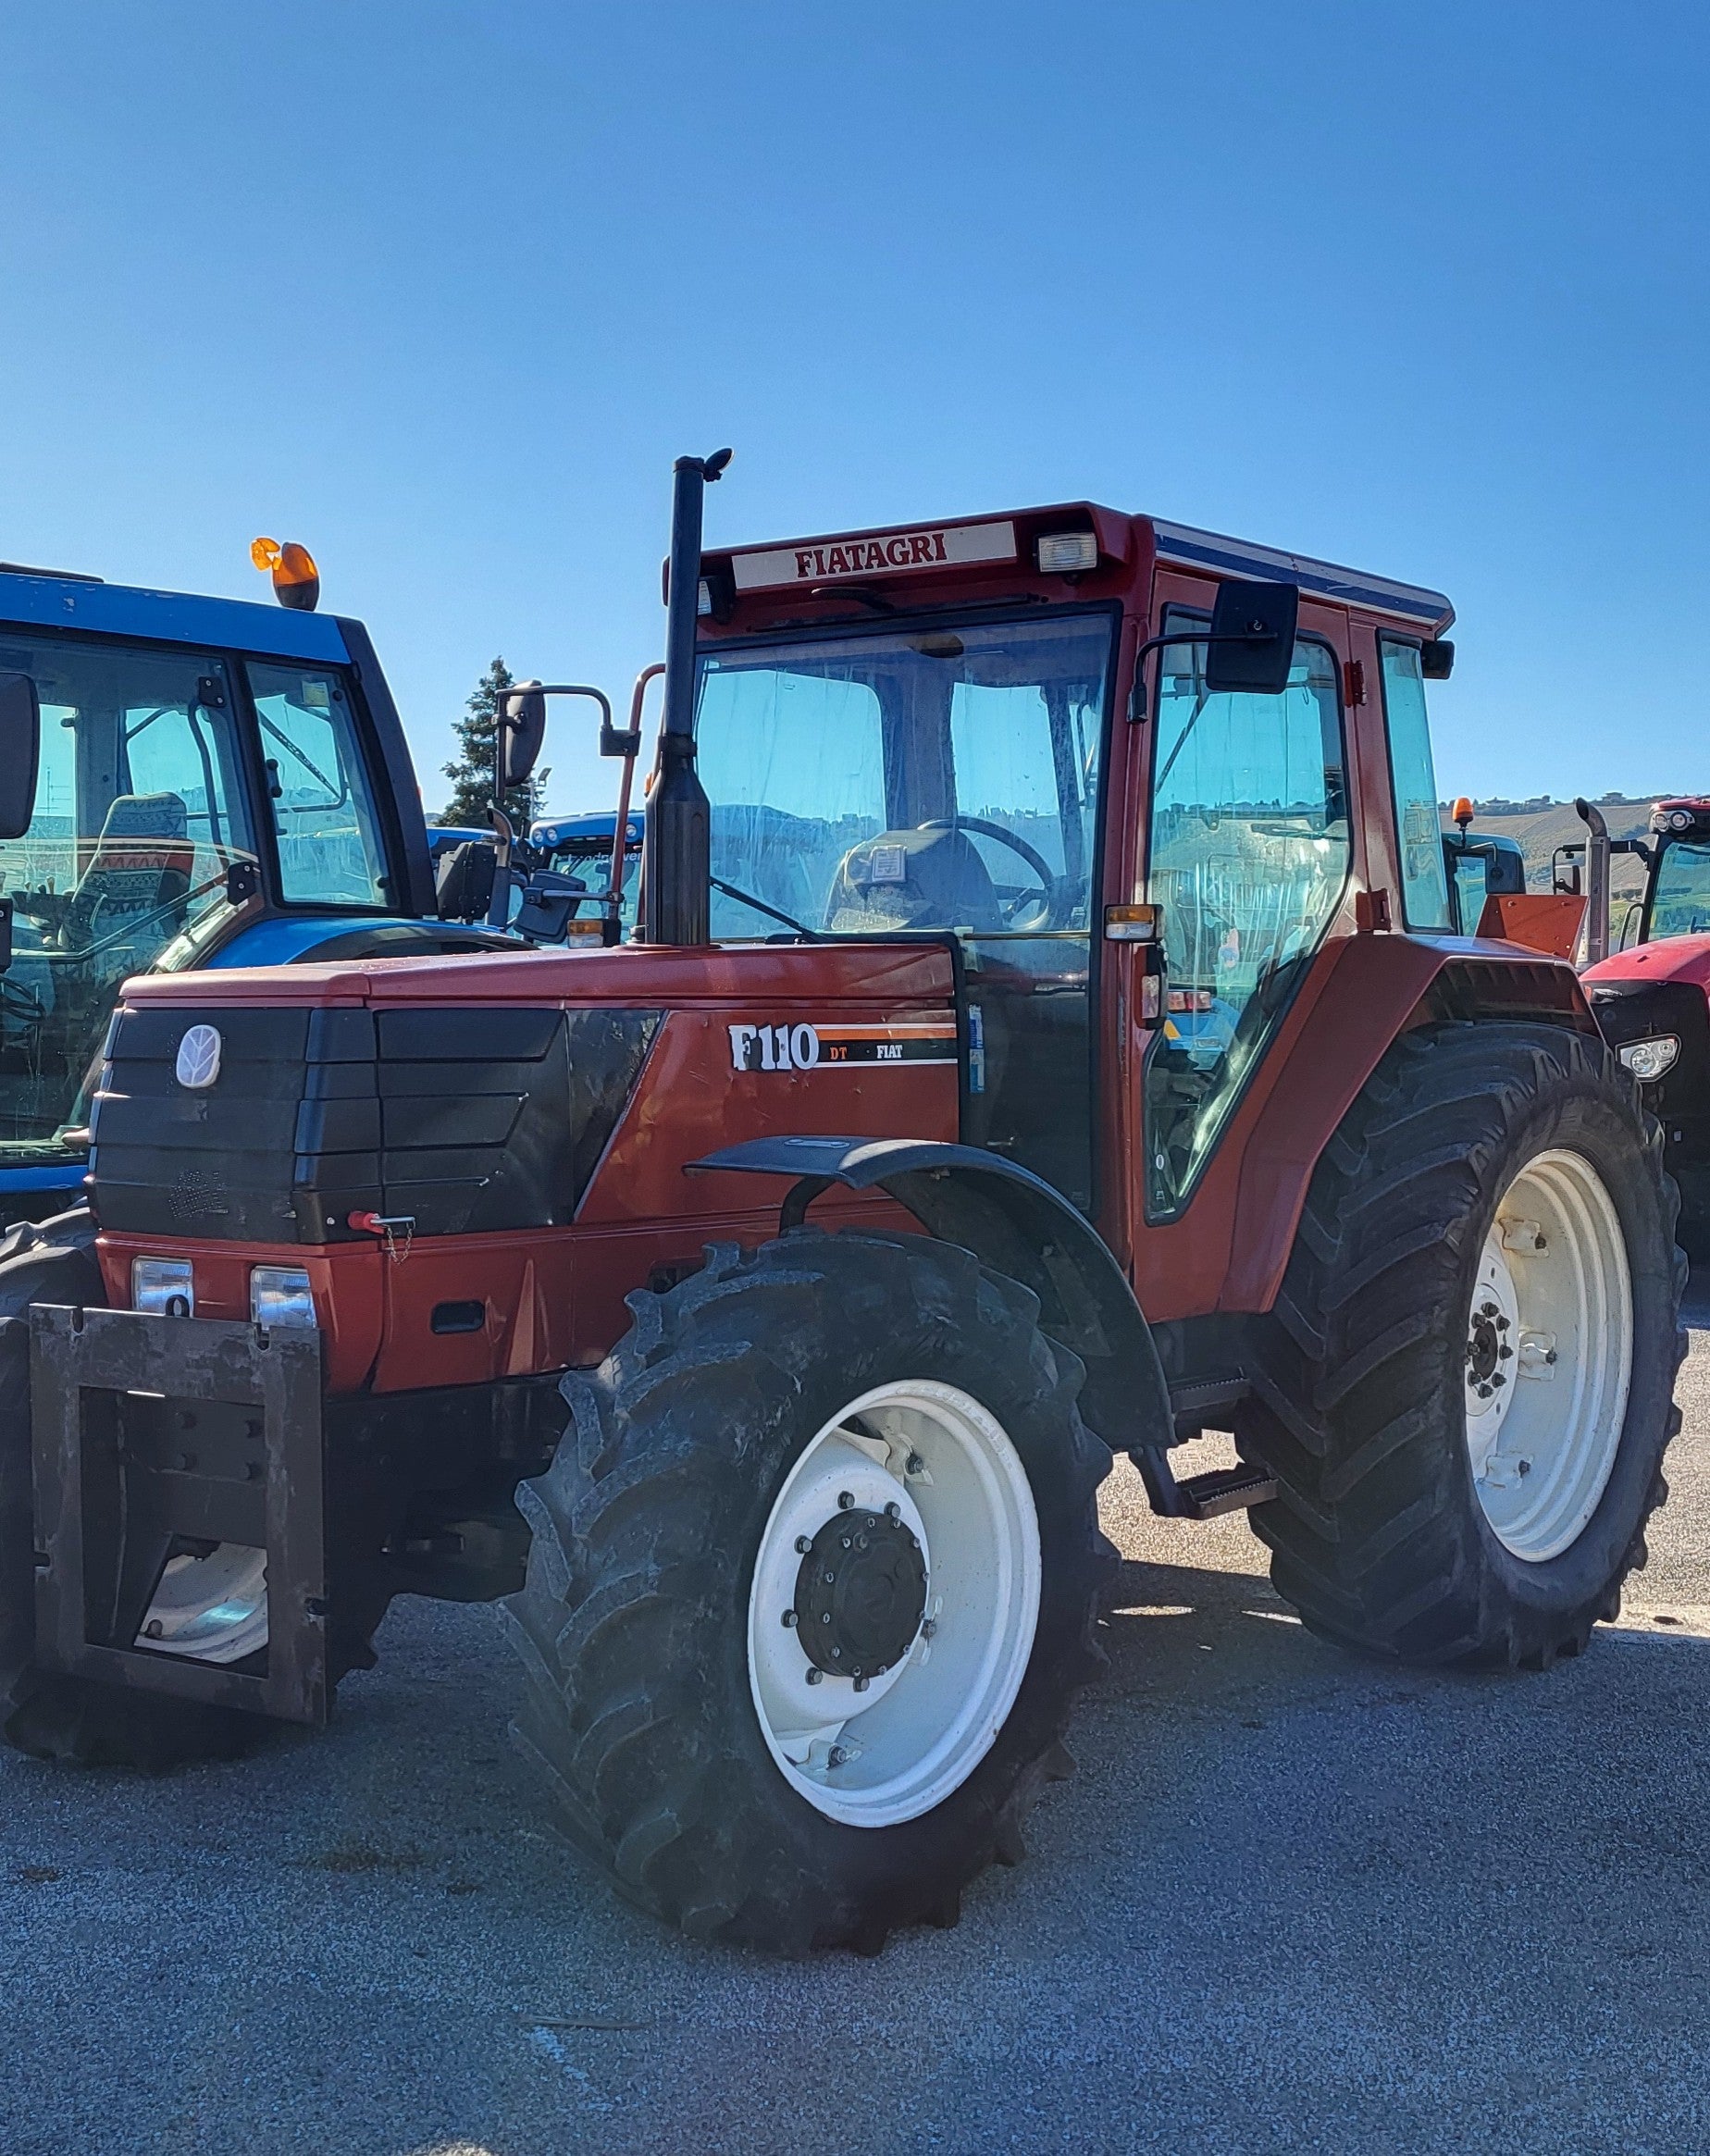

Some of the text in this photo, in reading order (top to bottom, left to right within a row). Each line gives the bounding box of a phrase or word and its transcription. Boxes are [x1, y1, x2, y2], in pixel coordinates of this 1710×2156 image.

[795, 533, 948, 577] FIATAGRI
[728, 1022, 903, 1071] F110 DT FIAT
